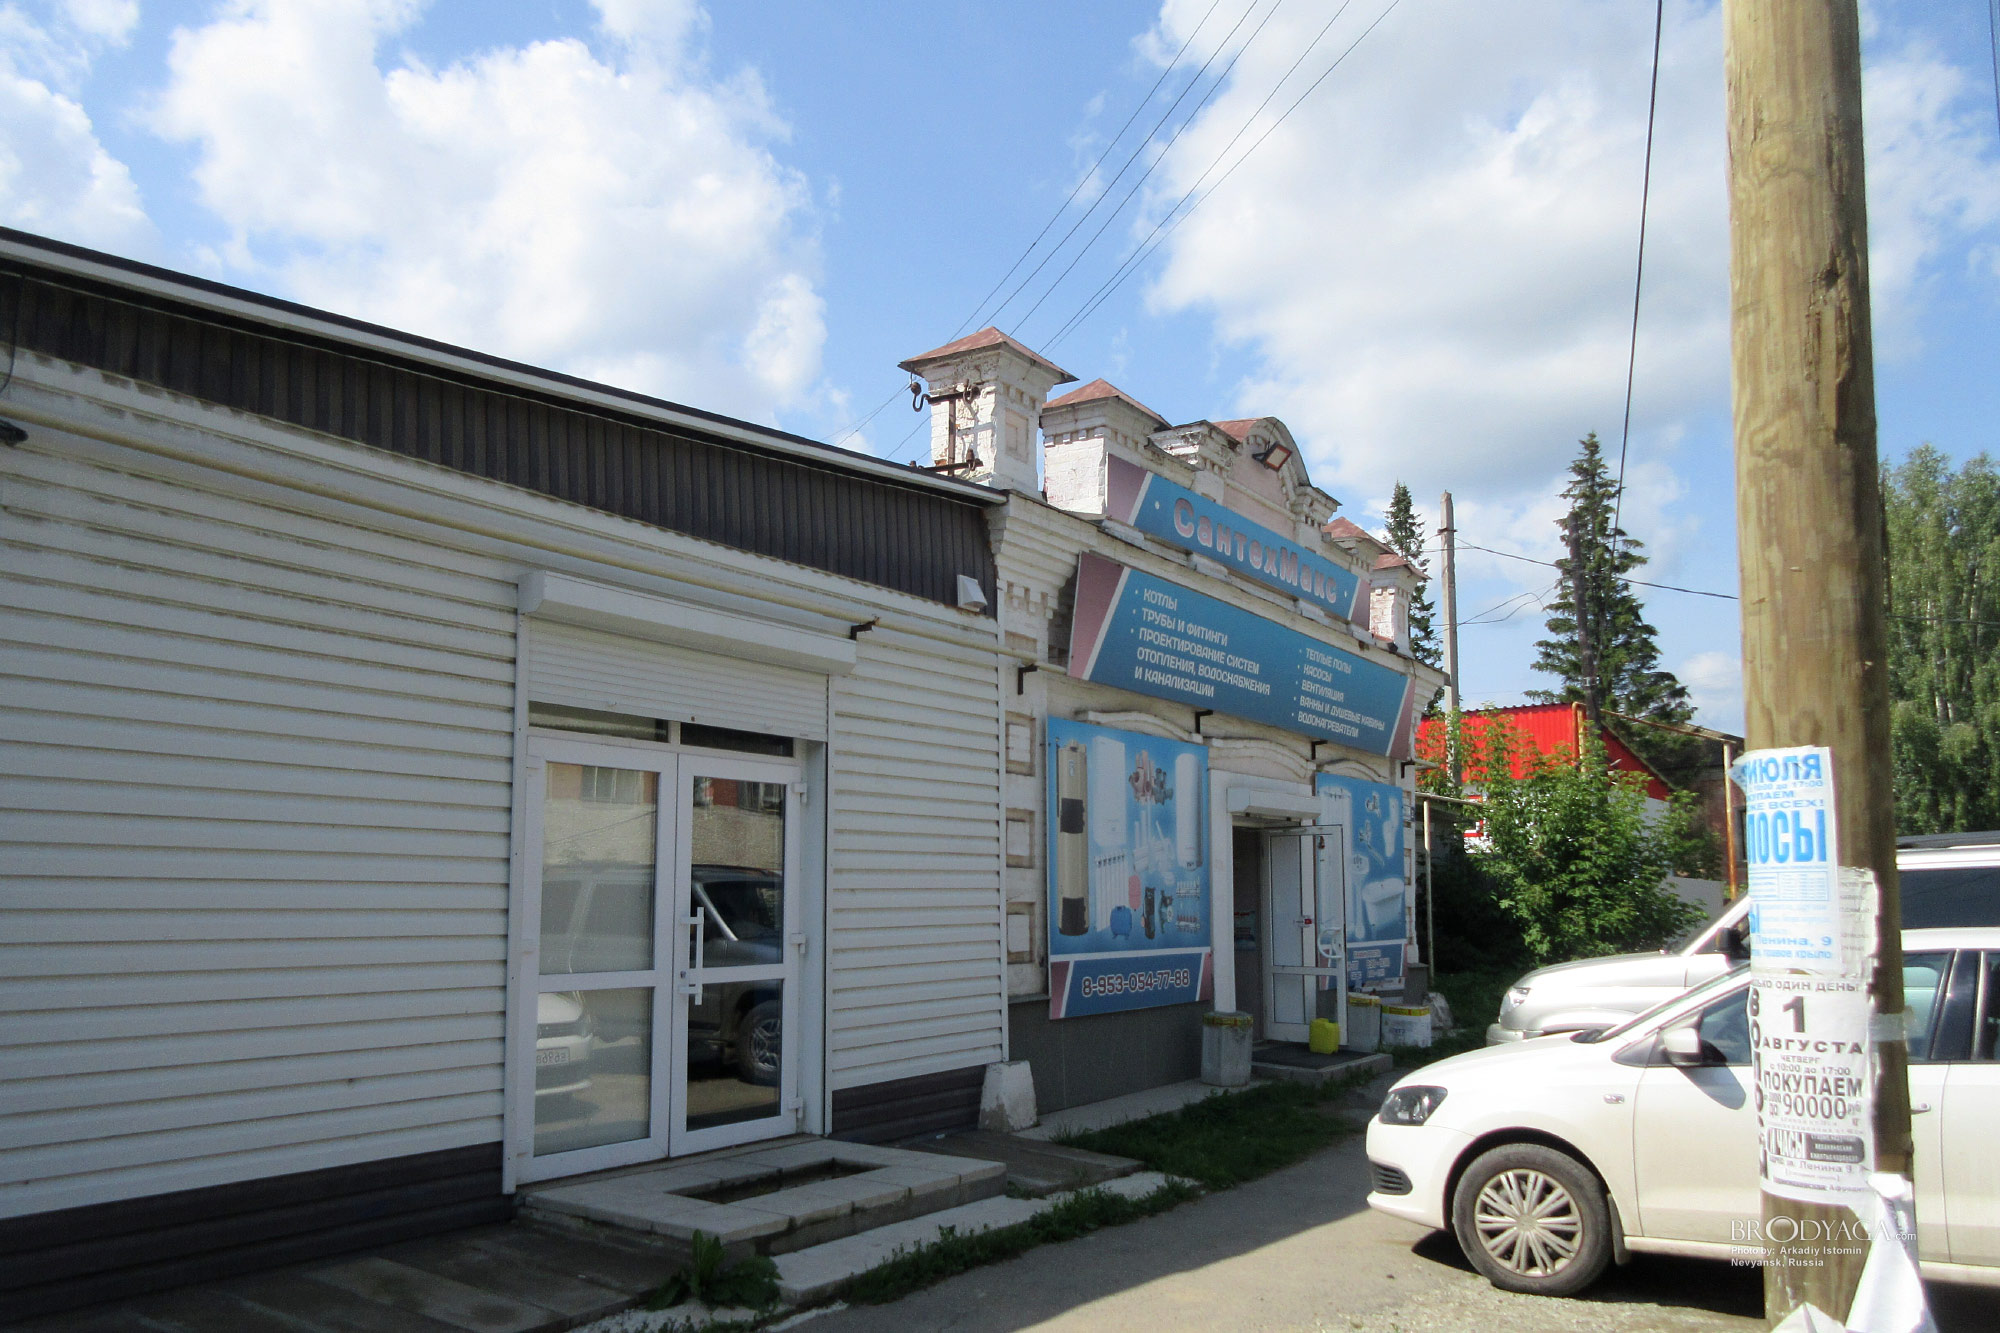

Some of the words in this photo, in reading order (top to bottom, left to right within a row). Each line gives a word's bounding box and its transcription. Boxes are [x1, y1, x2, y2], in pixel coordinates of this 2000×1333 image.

[1173, 497, 1337, 604] СантехМакс
[1143, 588, 1178, 611] КОТЛЫ
[1141, 607, 1176, 630] ТРУБЫ
[1177, 620, 1185, 633] И
[1186, 623, 1228, 647] ФИТИНГИ
[1139, 627, 1226, 665] ПРОЕКТИРОВАНИЕ
[1226, 653, 1260, 675] СИСТЕМ
[1306, 647, 1333, 667] ТЕПЛЫЕ
[1332, 658, 1352, 675] ПОЛЫ
[1134, 666, 1143, 680] И
[1144, 668, 1215, 698] КАНАЛИЗАЦИИ
[1137, 646, 1196, 676] ОТОПЛЕНИЯ,
[1197, 663, 1271, 696] ВОДОСНАБЖЕНИЯ
[1303, 663, 1333, 683] НАСОСЫ
[1301, 679, 1345, 703] ВЕНТИЛЯЦИЯ
[1297, 710, 1359, 738] ВОДОНАГРЕВАТЕЛИ
[1299, 695, 1324, 712] ВАННЫ
[1324, 703, 1330, 714] И
[1330, 705, 1361, 722] ДУШЕВЫЕ
[1360, 713, 1386, 731] КАБИНЫ
[1768, 799, 1825, 810] ВСЕХ!
[1821, 935, 1832, 946] 9
[1082, 968, 1190, 998] 8-953-054-77-88
[1775, 980, 1811, 991] ОДИН
[1782, 995, 1805, 1033] 1
[1762, 1036, 1864, 1055] АВГУСТА
[1780, 1054, 1821, 1064] ЧЕТВЕРГ
[1777, 1063, 1801, 1073] 10:00
[1822, 1066, 1851, 1076] 17:00
[1763, 1070, 1863, 1098] ПОКУПАЕМ
[1783, 1092, 1847, 1120] 90000
[1799, 1161, 1842, 1173] Ленина
